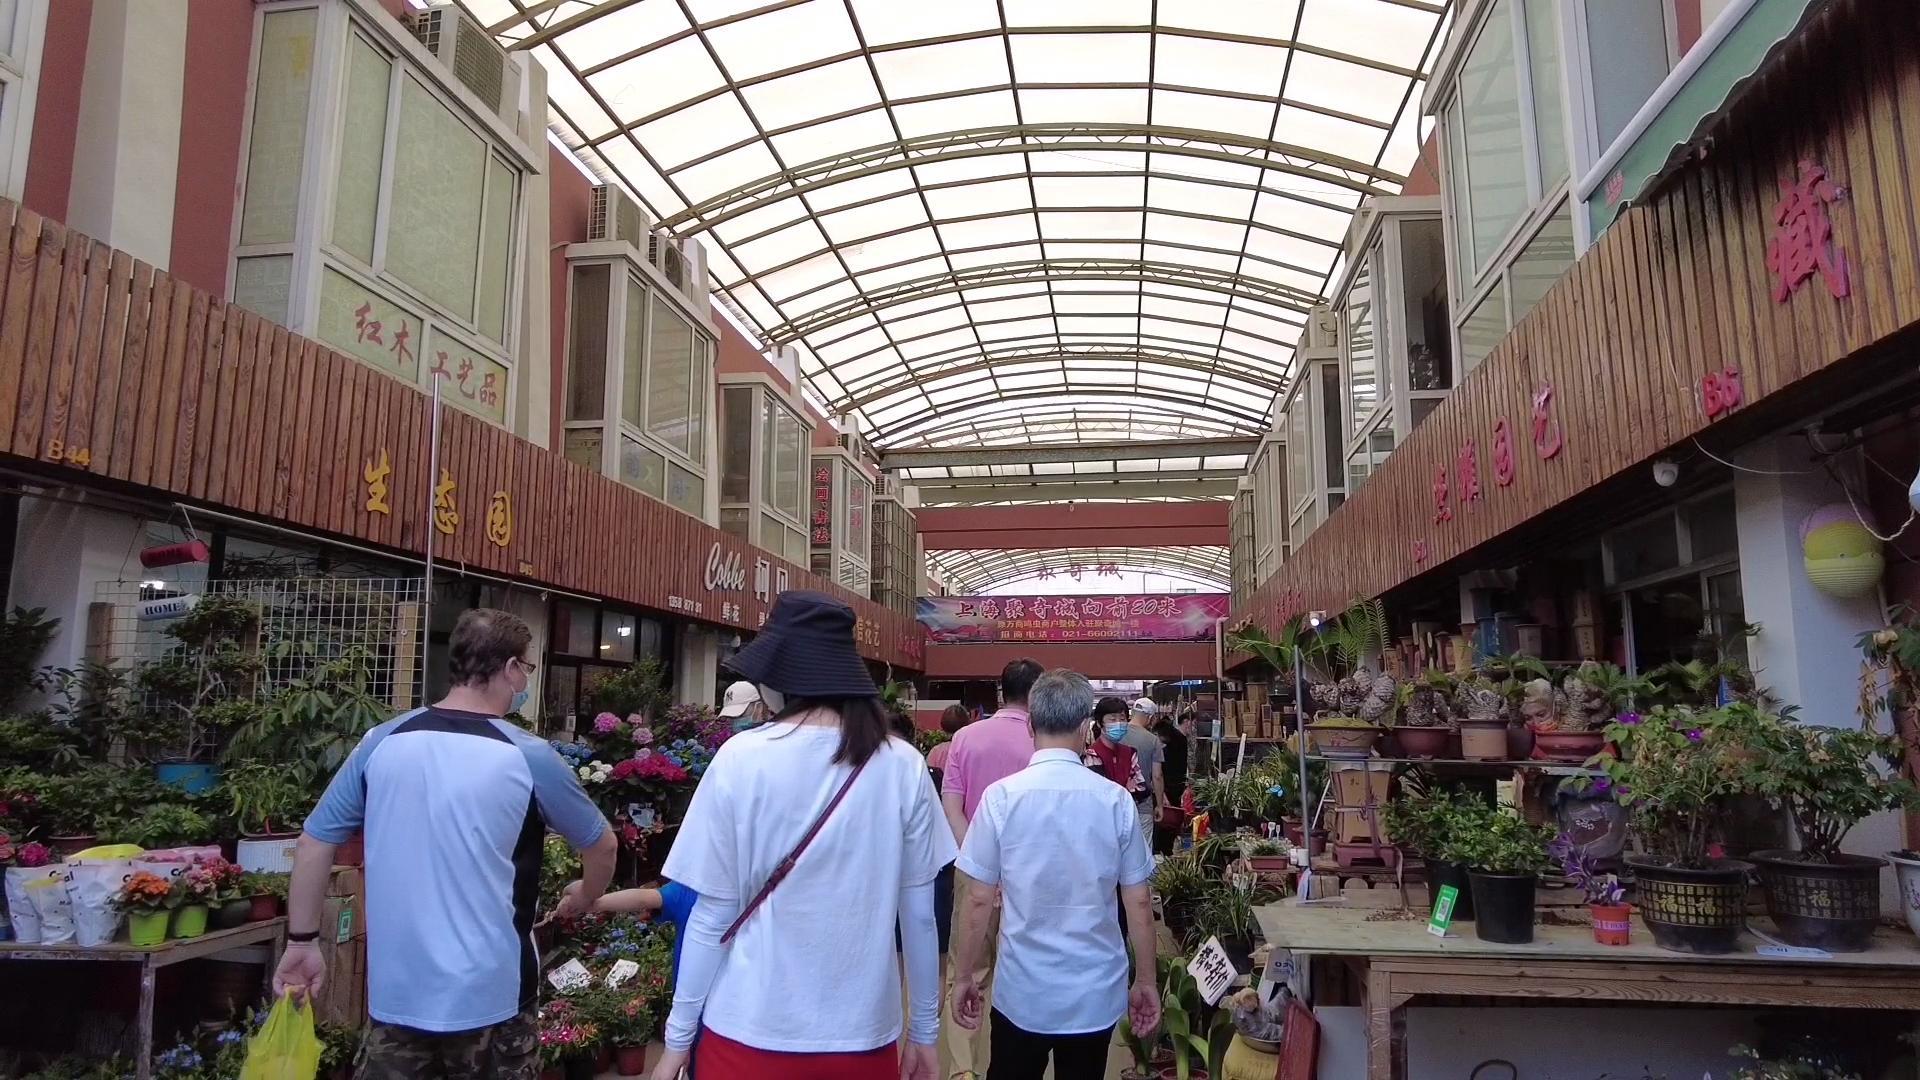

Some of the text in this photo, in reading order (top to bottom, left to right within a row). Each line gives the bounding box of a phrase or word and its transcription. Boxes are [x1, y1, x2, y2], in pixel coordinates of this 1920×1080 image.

[355, 302, 497, 407] 红木 工艺品
[1702, 366, 1741, 417] B6
[364, 447, 512, 547] 生态园
[704, 541, 746, 591] Cobbe
[955, 596, 1183, 620] 上海聚奇城向前20米
